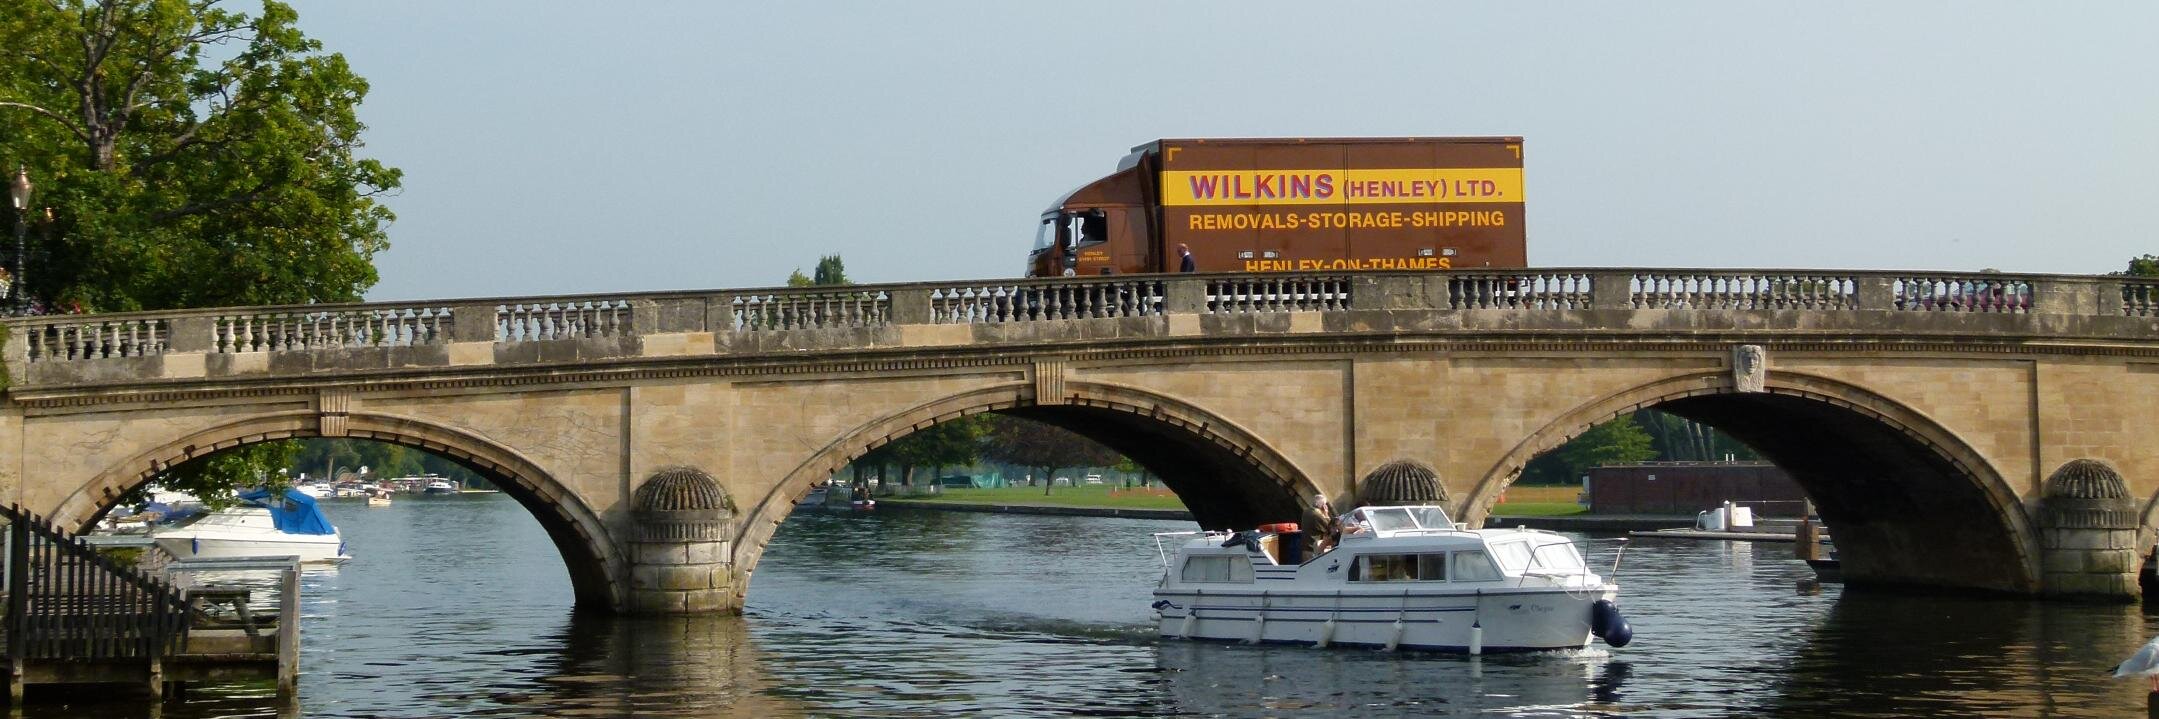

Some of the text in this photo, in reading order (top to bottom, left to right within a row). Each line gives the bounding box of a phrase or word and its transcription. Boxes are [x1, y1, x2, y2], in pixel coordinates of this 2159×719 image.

[1189, 173, 1503, 200] WILKINS (HENLEY) LTD.
[1189, 211, 1505, 230] REMOVALS-STORAGE-SHIPPING
